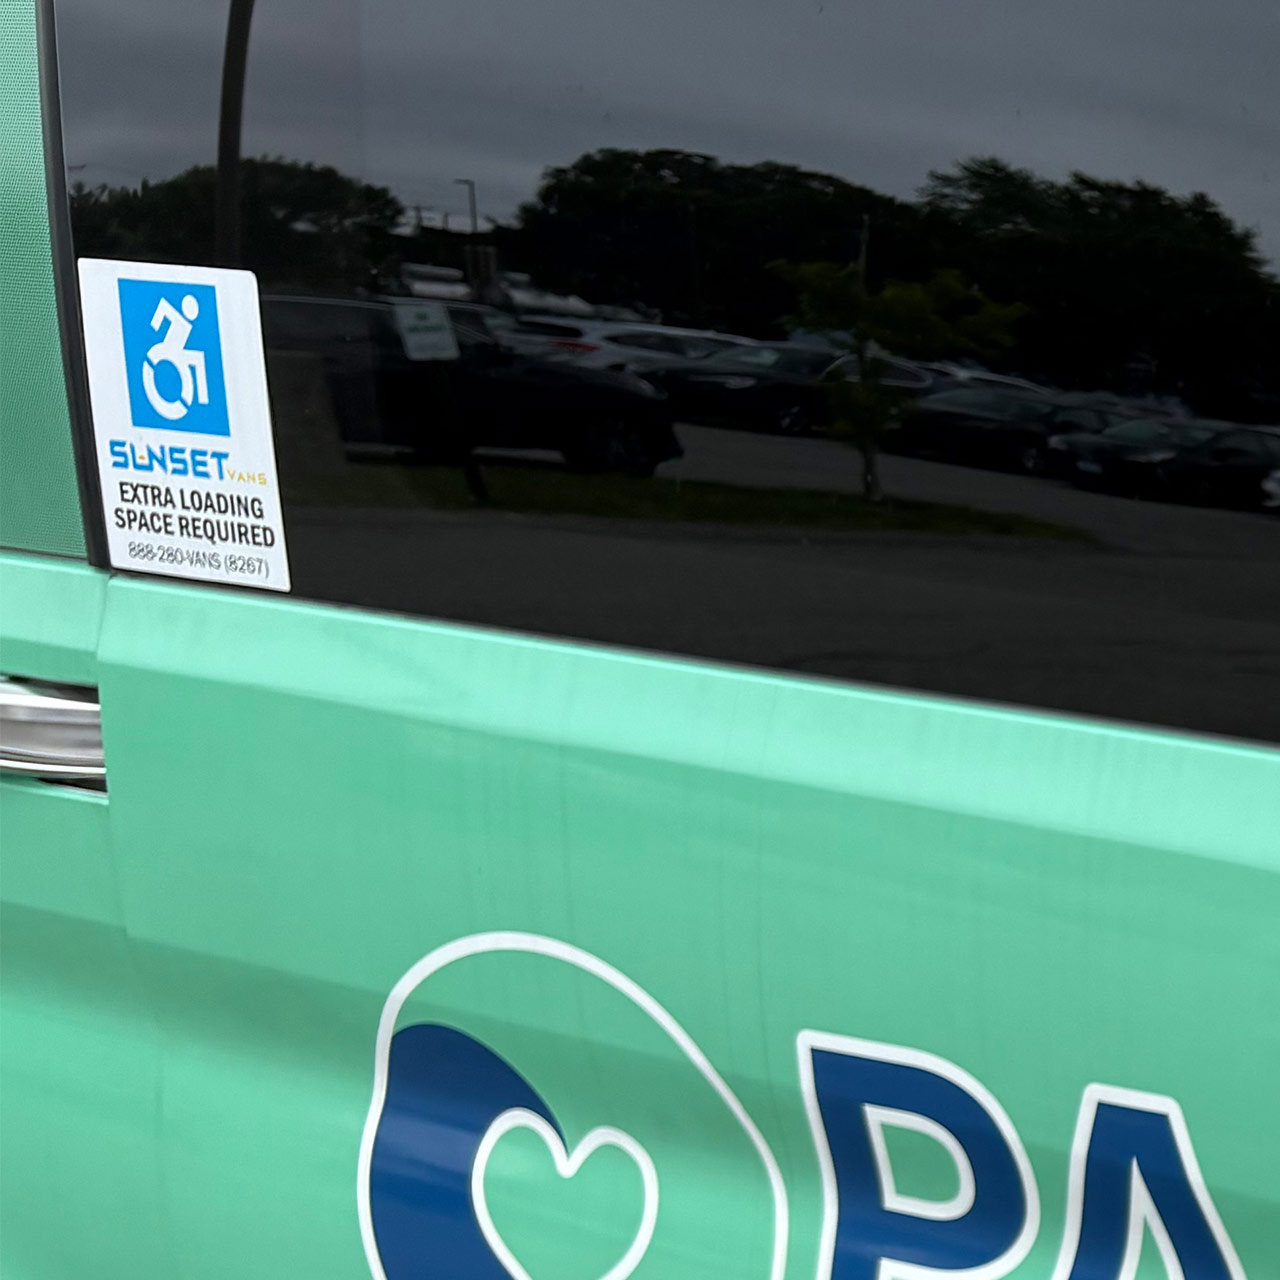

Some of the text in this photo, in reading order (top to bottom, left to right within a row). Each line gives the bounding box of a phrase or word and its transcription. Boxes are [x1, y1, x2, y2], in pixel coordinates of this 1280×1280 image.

[109, 439, 268, 486] SUNSET VANS
[118, 480, 265, 520] EXTRA LOADING
[114, 506, 276, 548] SPACE REQUIRED
[224, 553, 270, 580] (8267)
